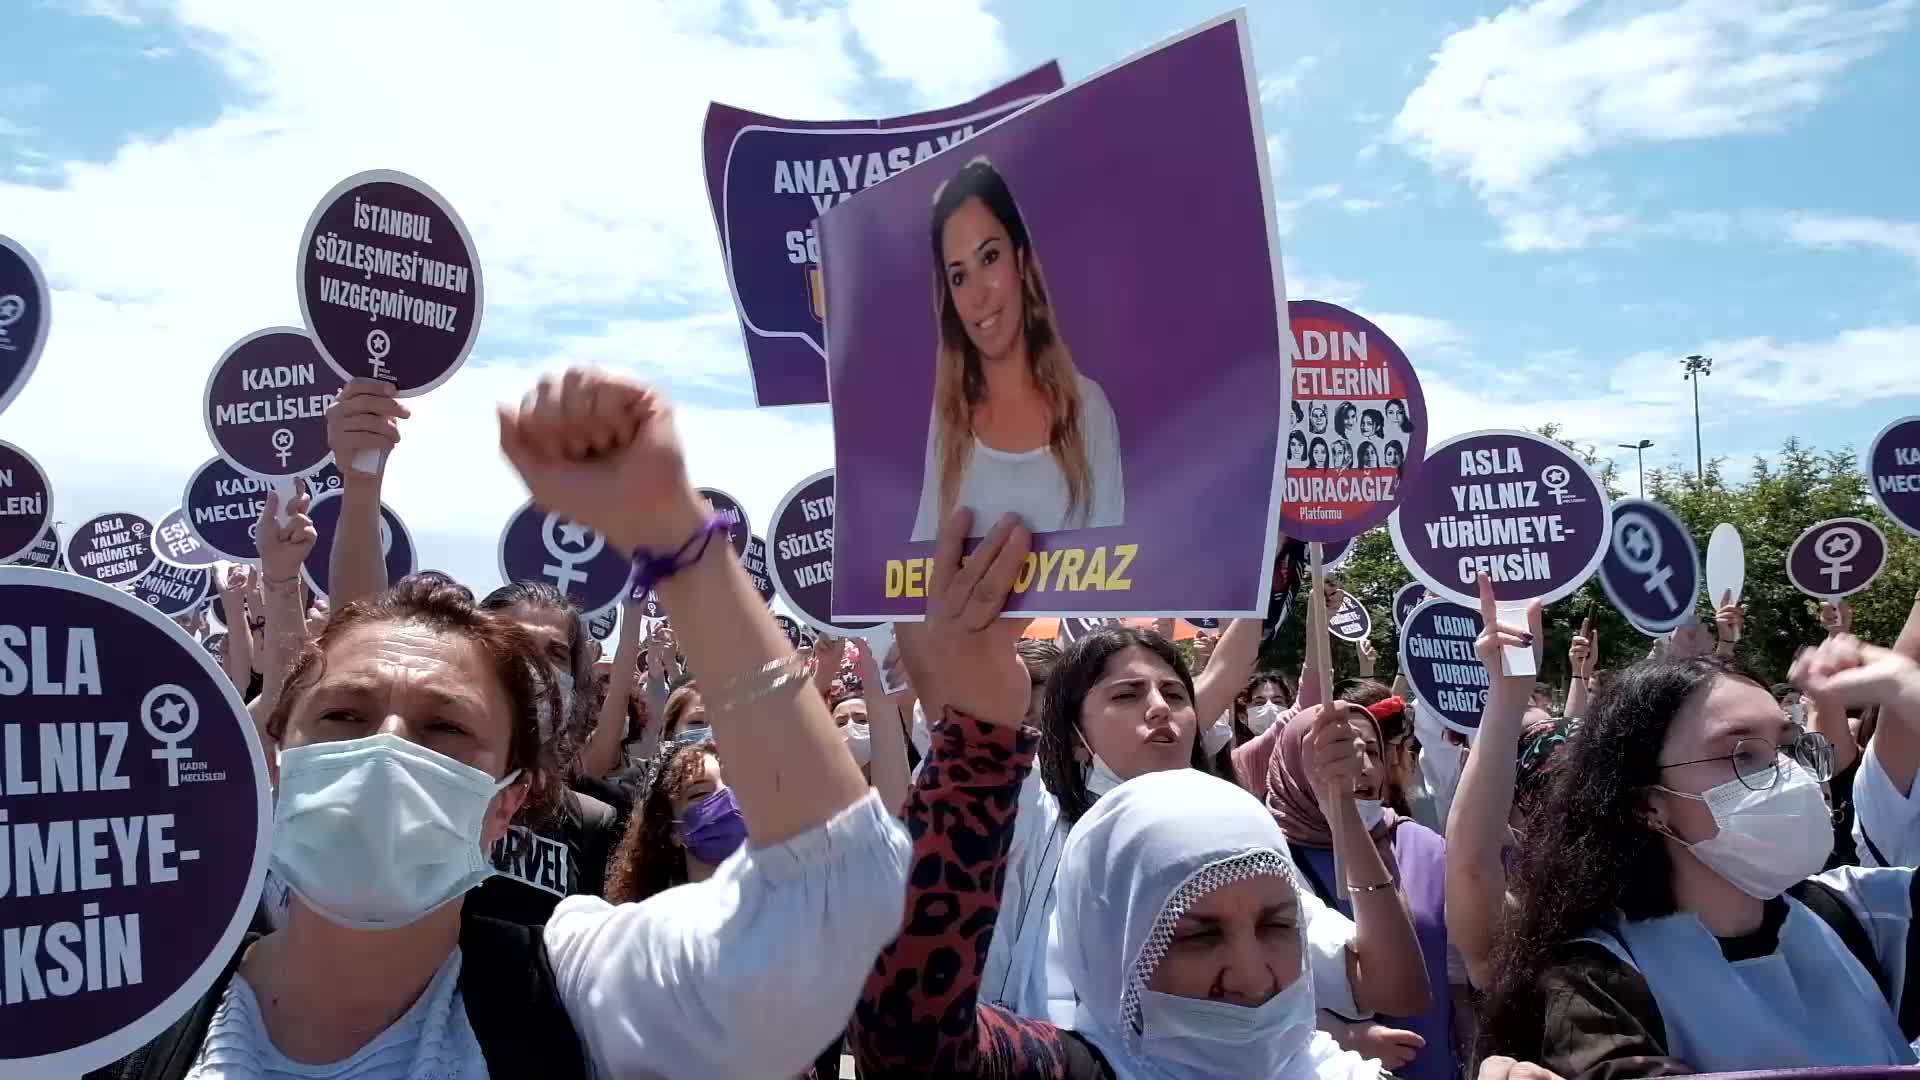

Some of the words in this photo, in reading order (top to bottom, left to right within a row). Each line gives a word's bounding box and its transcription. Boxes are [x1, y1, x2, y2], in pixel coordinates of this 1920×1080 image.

[353, 196, 433, 244] İSTANBUL
[315, 231, 469, 294] SÖZLEŞMESİ'NDEN
[320, 276, 458, 333] VAZGEÇMİYORUZ
[242, 363, 315, 391] KADIN
[1460, 447, 1524, 477] ASLA
[1451, 481, 1540, 512] YALNIZ
[94, 517, 124, 535] ASLA
[1299, 506, 1343, 520] Platformu
[91, 531, 132, 549] YALNIZ
[1424, 514, 1575, 549] YÜRÜMEYE-
[1433, 615, 1477, 638] KADIN
[1437, 687, 1481, 713] CAĞIZ
